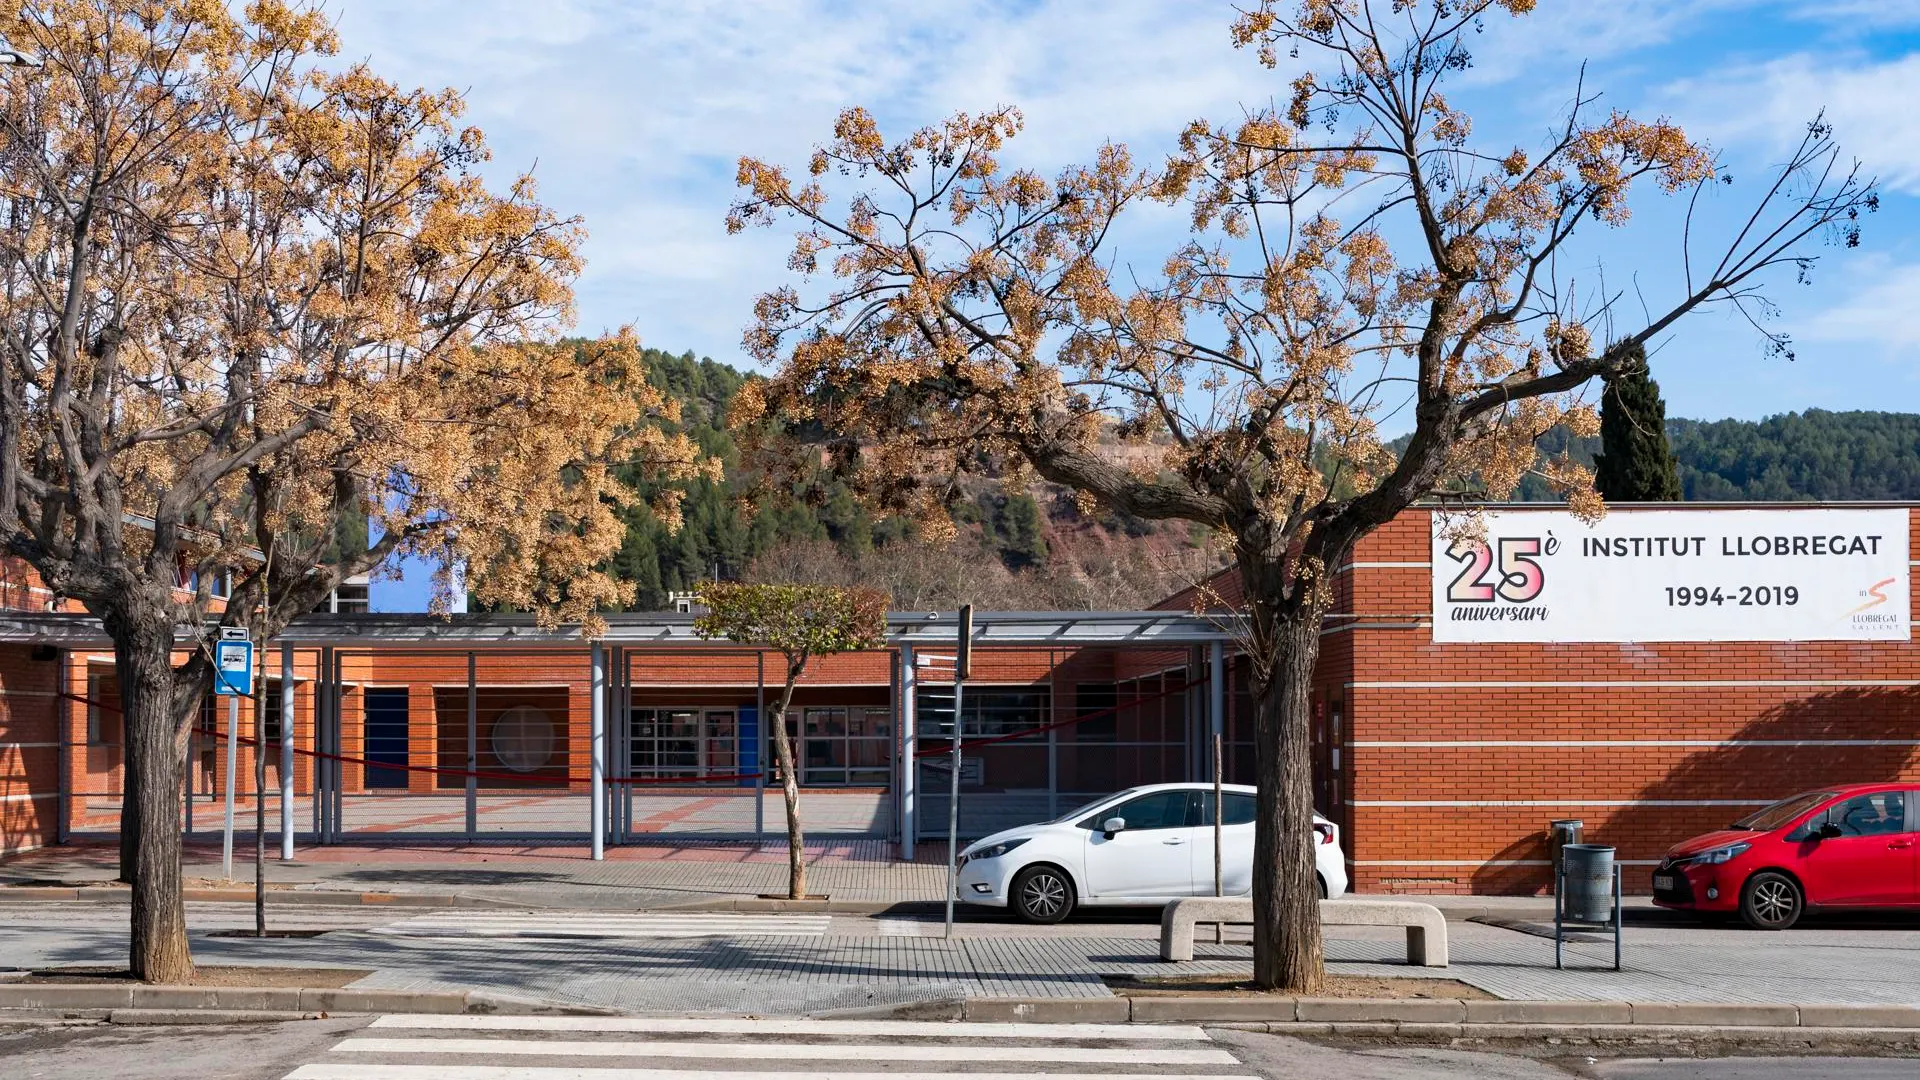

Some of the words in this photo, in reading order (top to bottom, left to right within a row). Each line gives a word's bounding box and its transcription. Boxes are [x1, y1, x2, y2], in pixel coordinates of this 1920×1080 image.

[1583, 537, 1706, 557] INSTITUT
[1722, 535, 1882, 556] LLOBREGAT
[1665, 586, 1799, 607] 1994-2019
[1451, 605, 1549, 621] aniversari
[1852, 614, 1897, 623] LLOBREGAT
